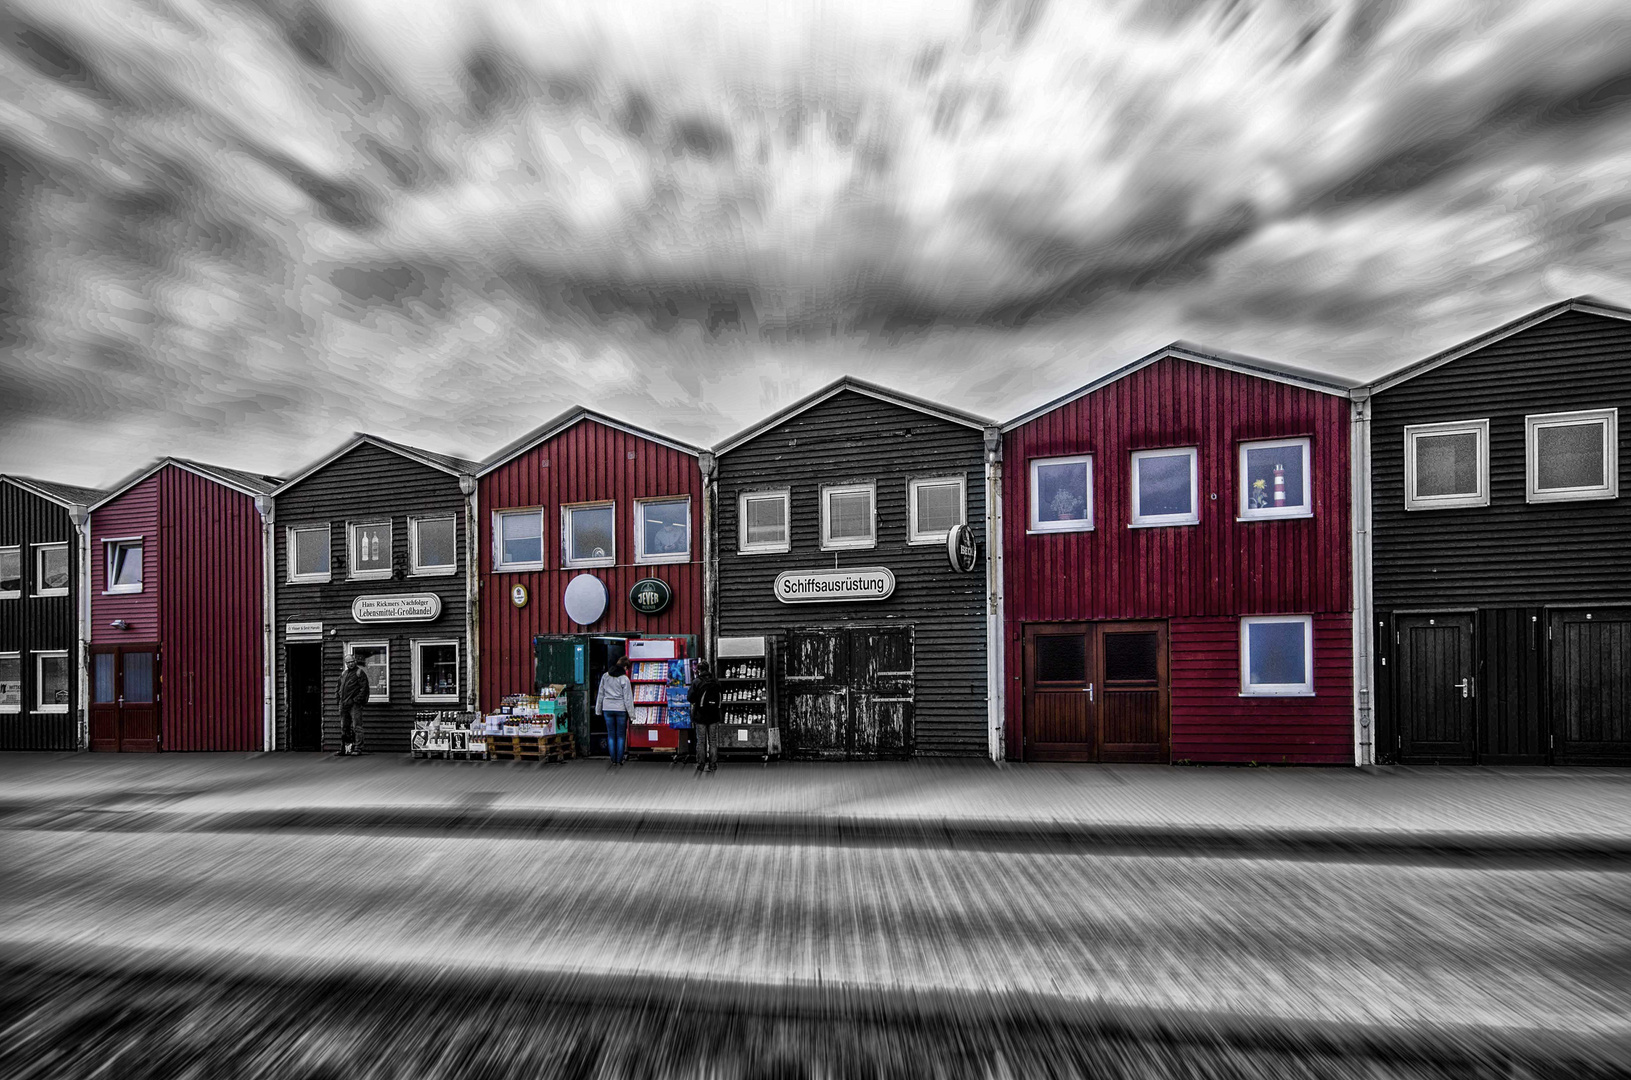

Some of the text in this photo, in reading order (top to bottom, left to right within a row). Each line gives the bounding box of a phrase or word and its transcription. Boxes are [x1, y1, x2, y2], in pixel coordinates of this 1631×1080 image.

[784, 577, 884, 593] Schiffsausrüstung
[401, 599, 429, 607] Nachfolger
[637, 591, 659, 606] JEVER
[359, 606, 432, 617] Lebensmittel-Großhandel
